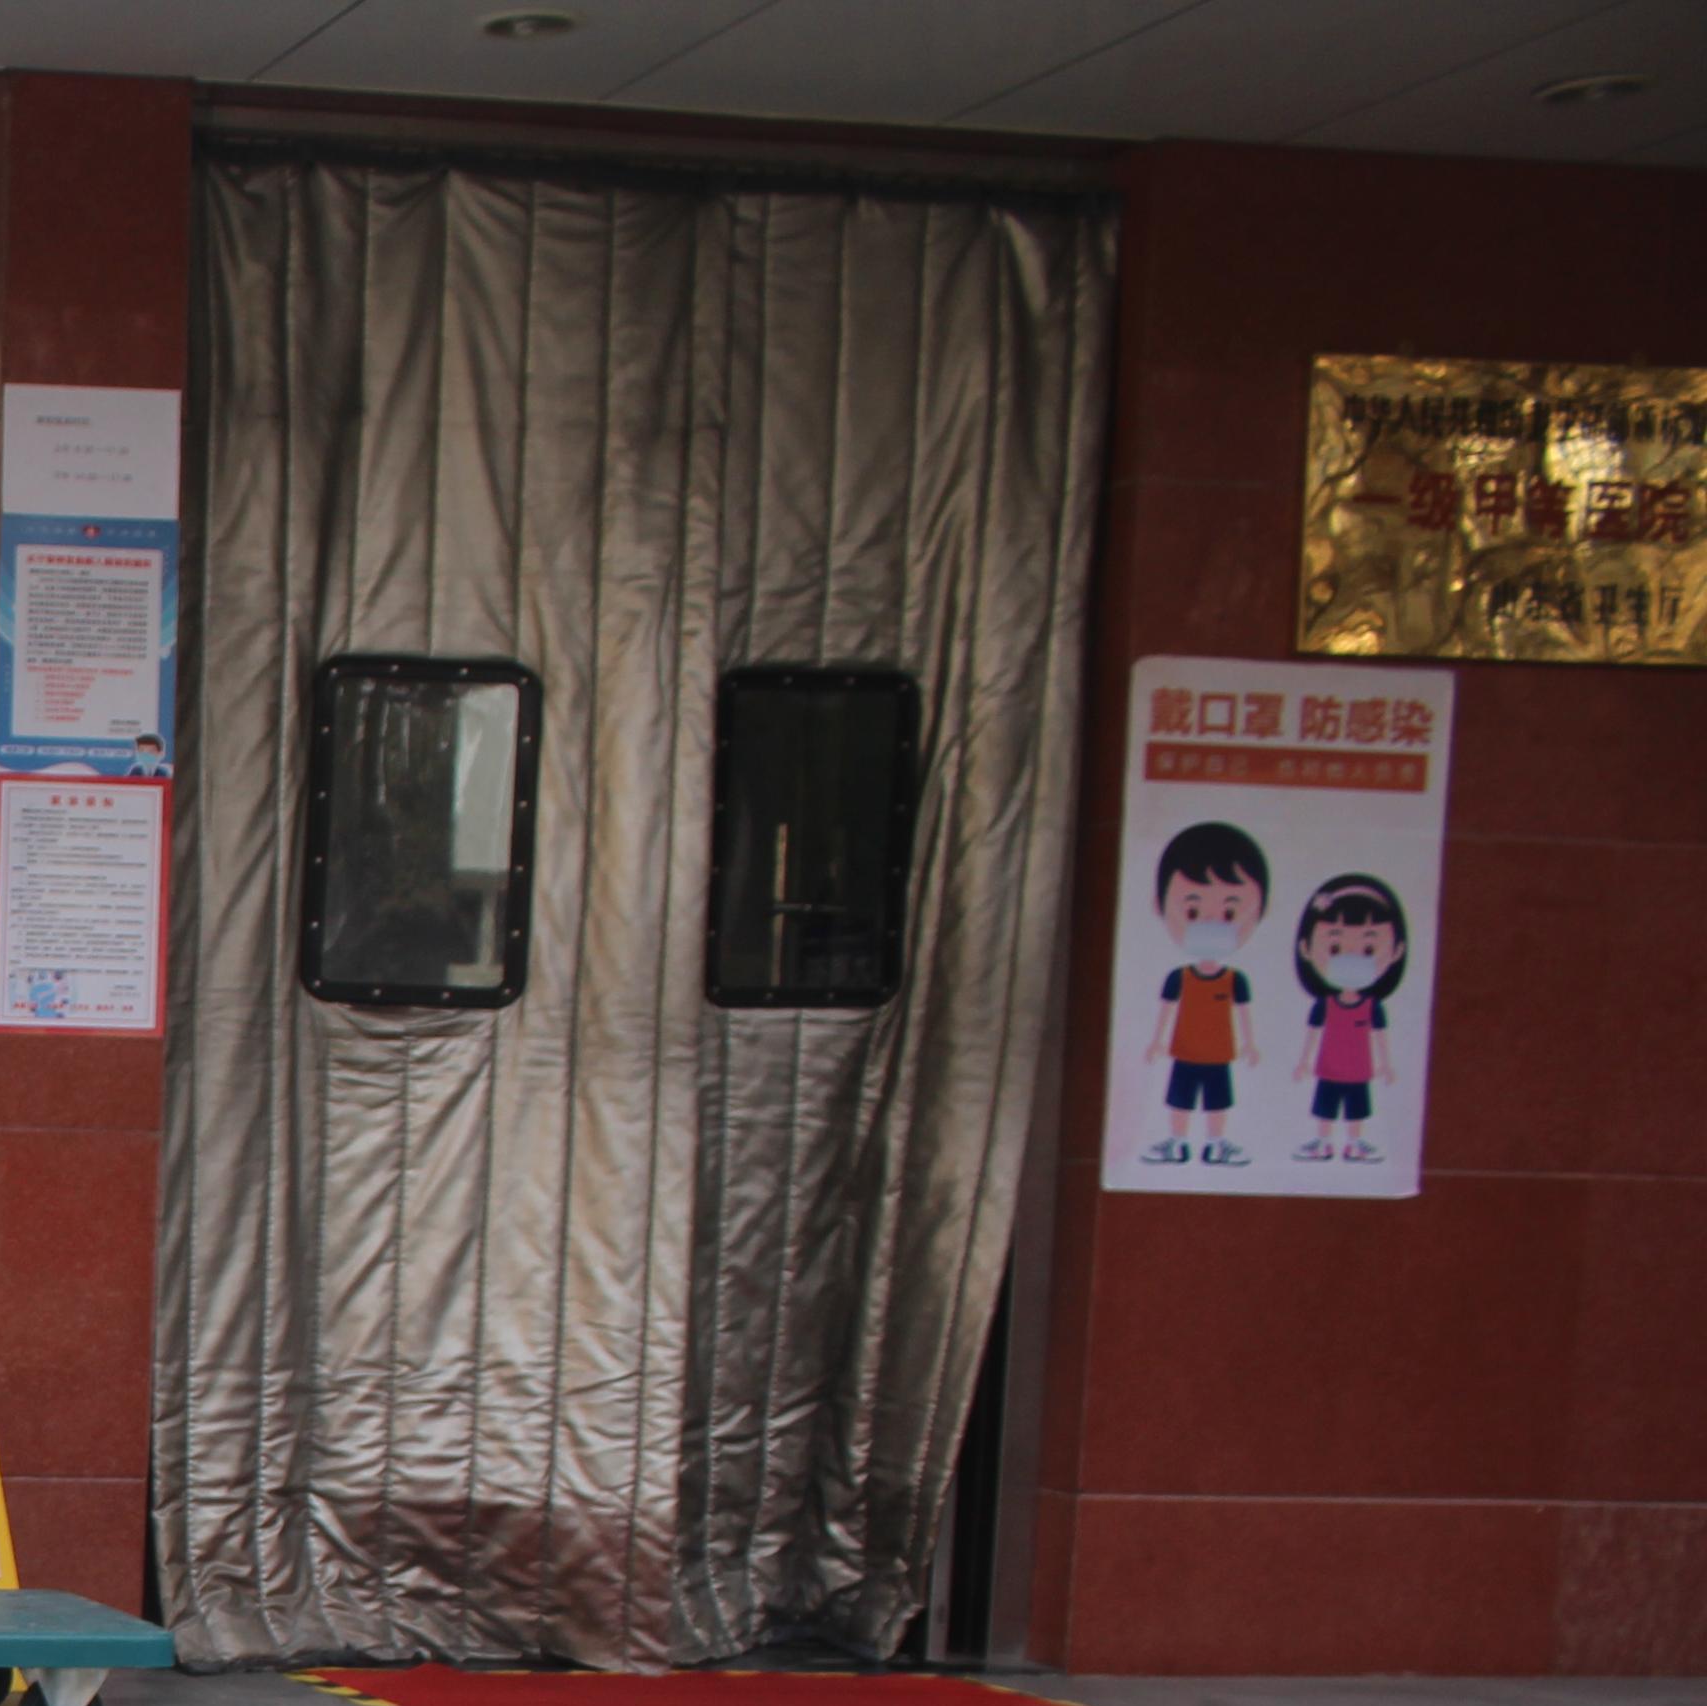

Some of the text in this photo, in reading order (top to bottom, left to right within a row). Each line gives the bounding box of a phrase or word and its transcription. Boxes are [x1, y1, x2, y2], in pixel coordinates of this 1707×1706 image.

[1352, 473, 1691, 542] 一级甲等医院
[1149, 686, 1434, 747] 戴口罩 防感染
